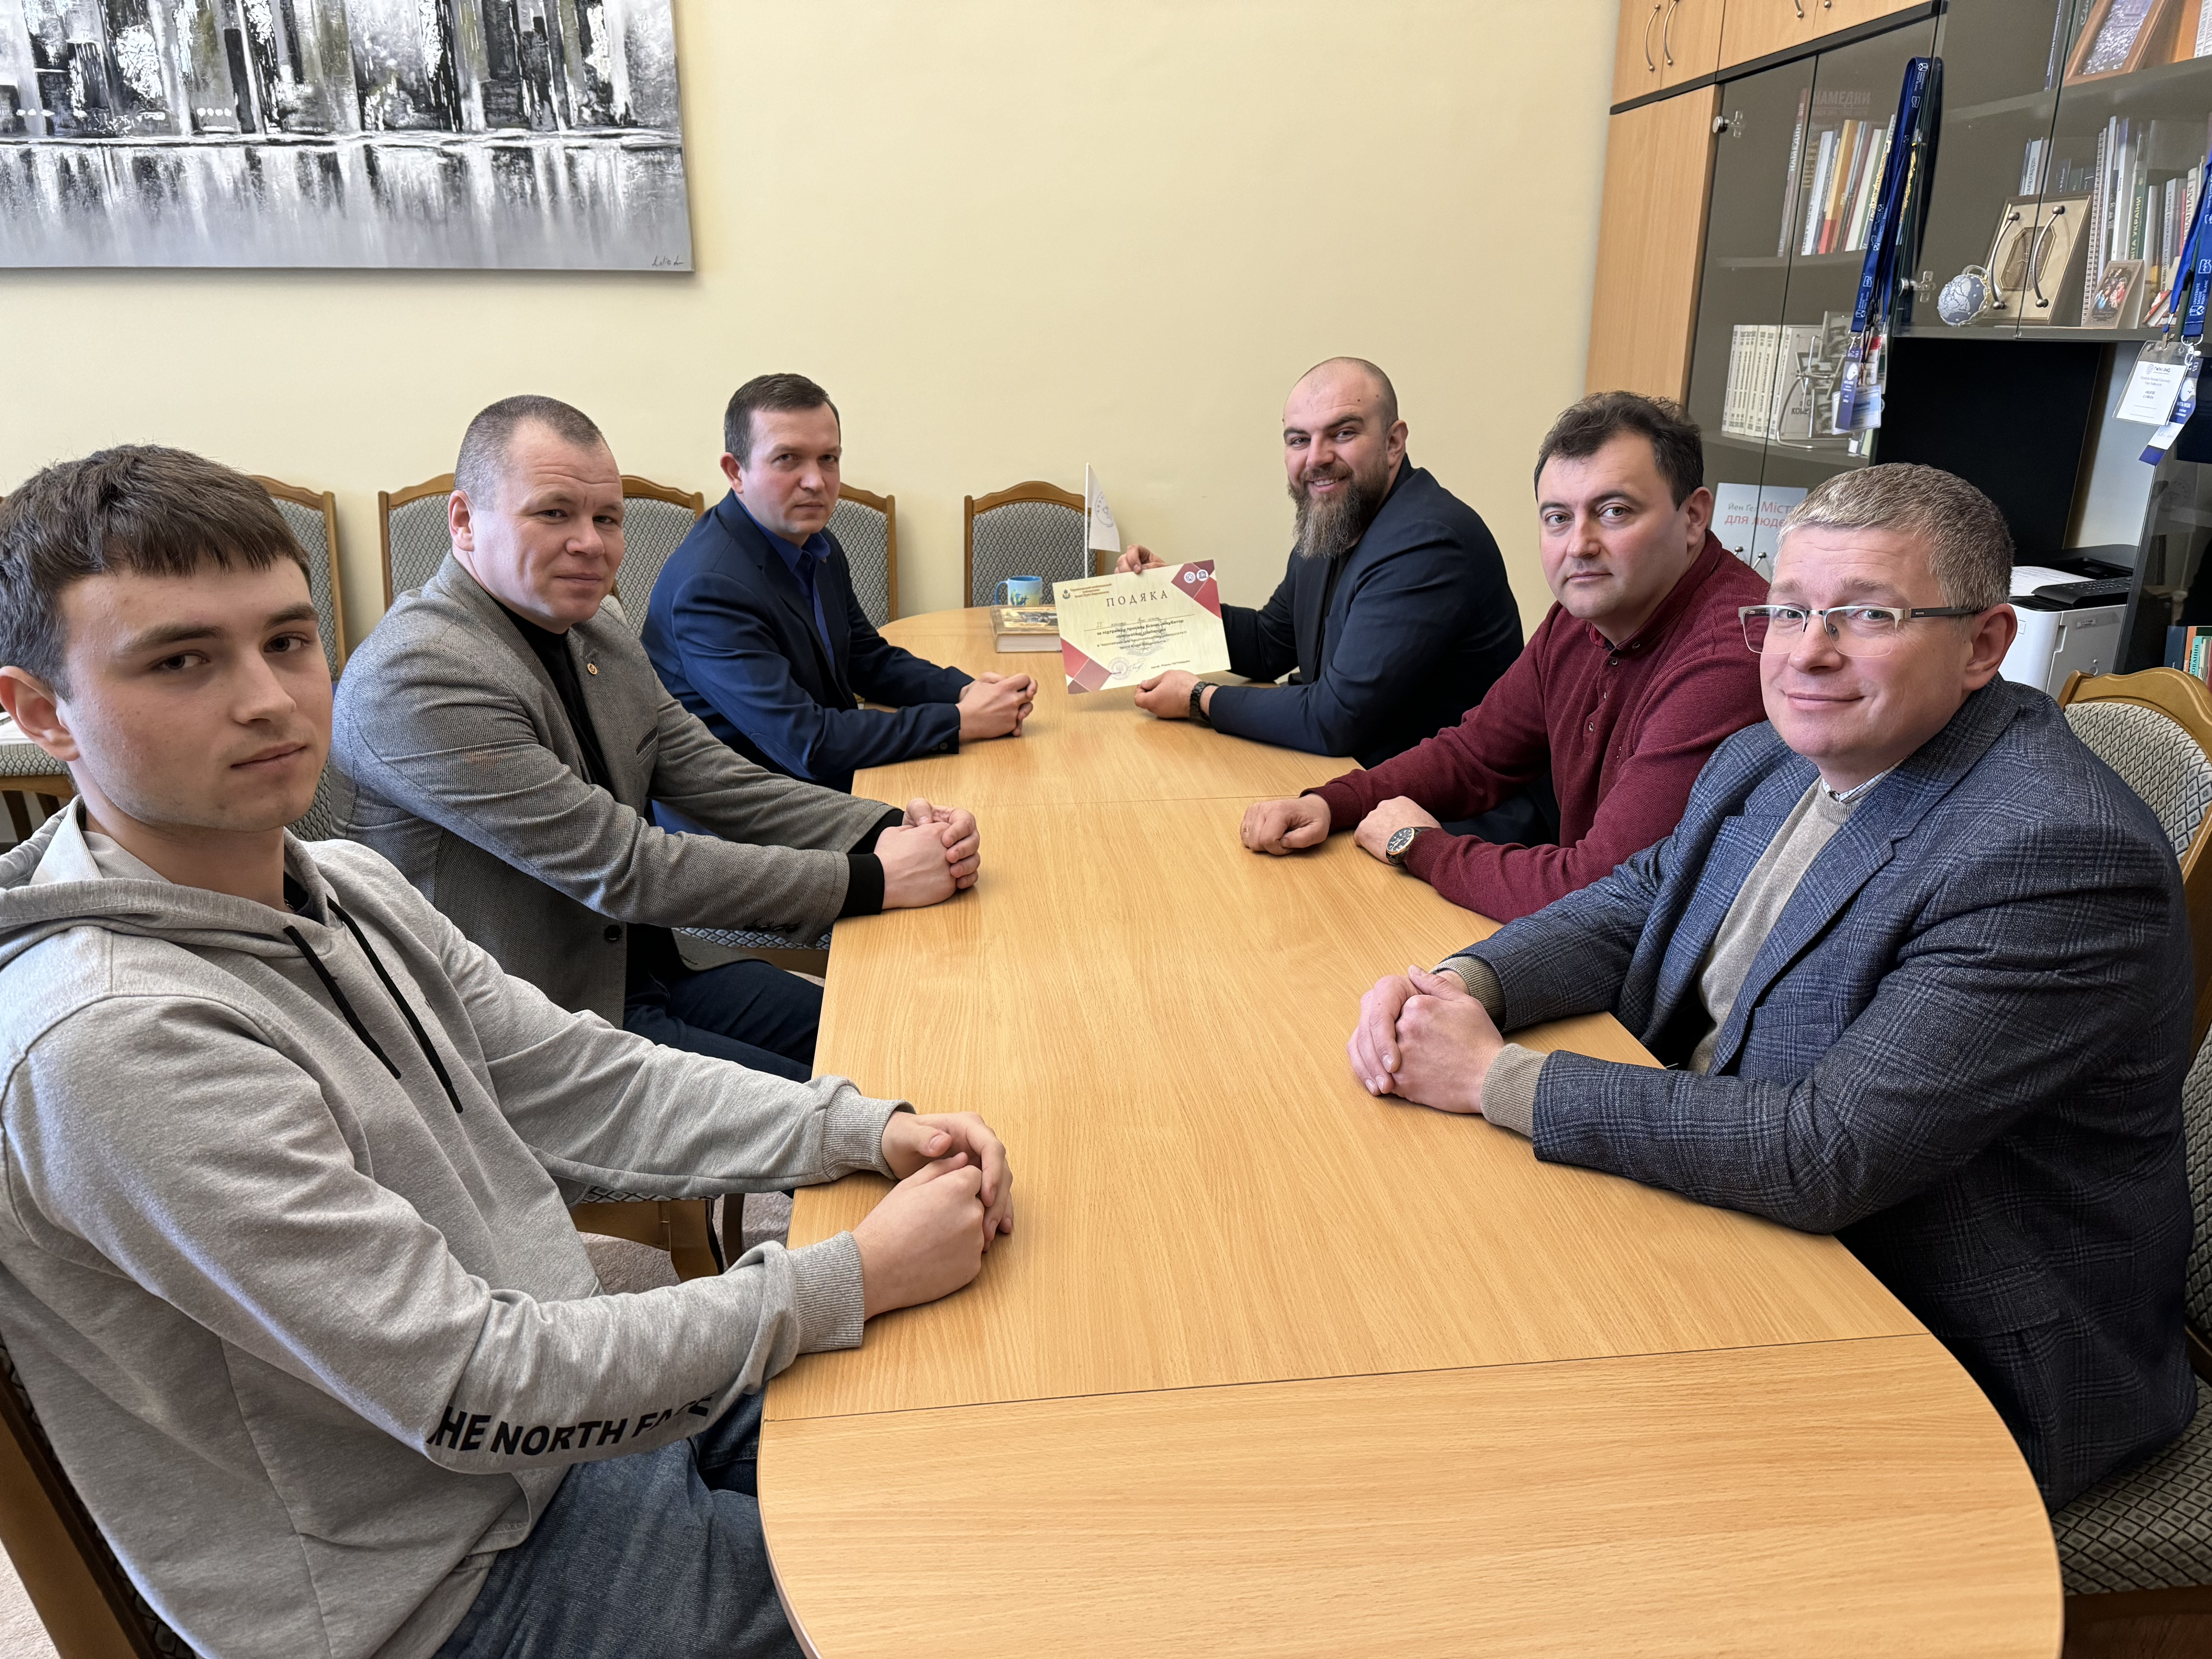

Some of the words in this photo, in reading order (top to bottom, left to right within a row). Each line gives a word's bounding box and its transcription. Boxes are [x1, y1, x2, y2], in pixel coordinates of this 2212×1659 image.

[2132, 196, 2142, 237] УКРАЇНИ
[1728, 502, 1743, 510] Йен
[1761, 501, 1795, 514] Міст
[1724, 515, 1749, 526] для
[1751, 517, 1786, 529] люде
[1106, 590, 1168, 607] ПОДЯКА
[490, 1418, 628, 1456] NORTH
